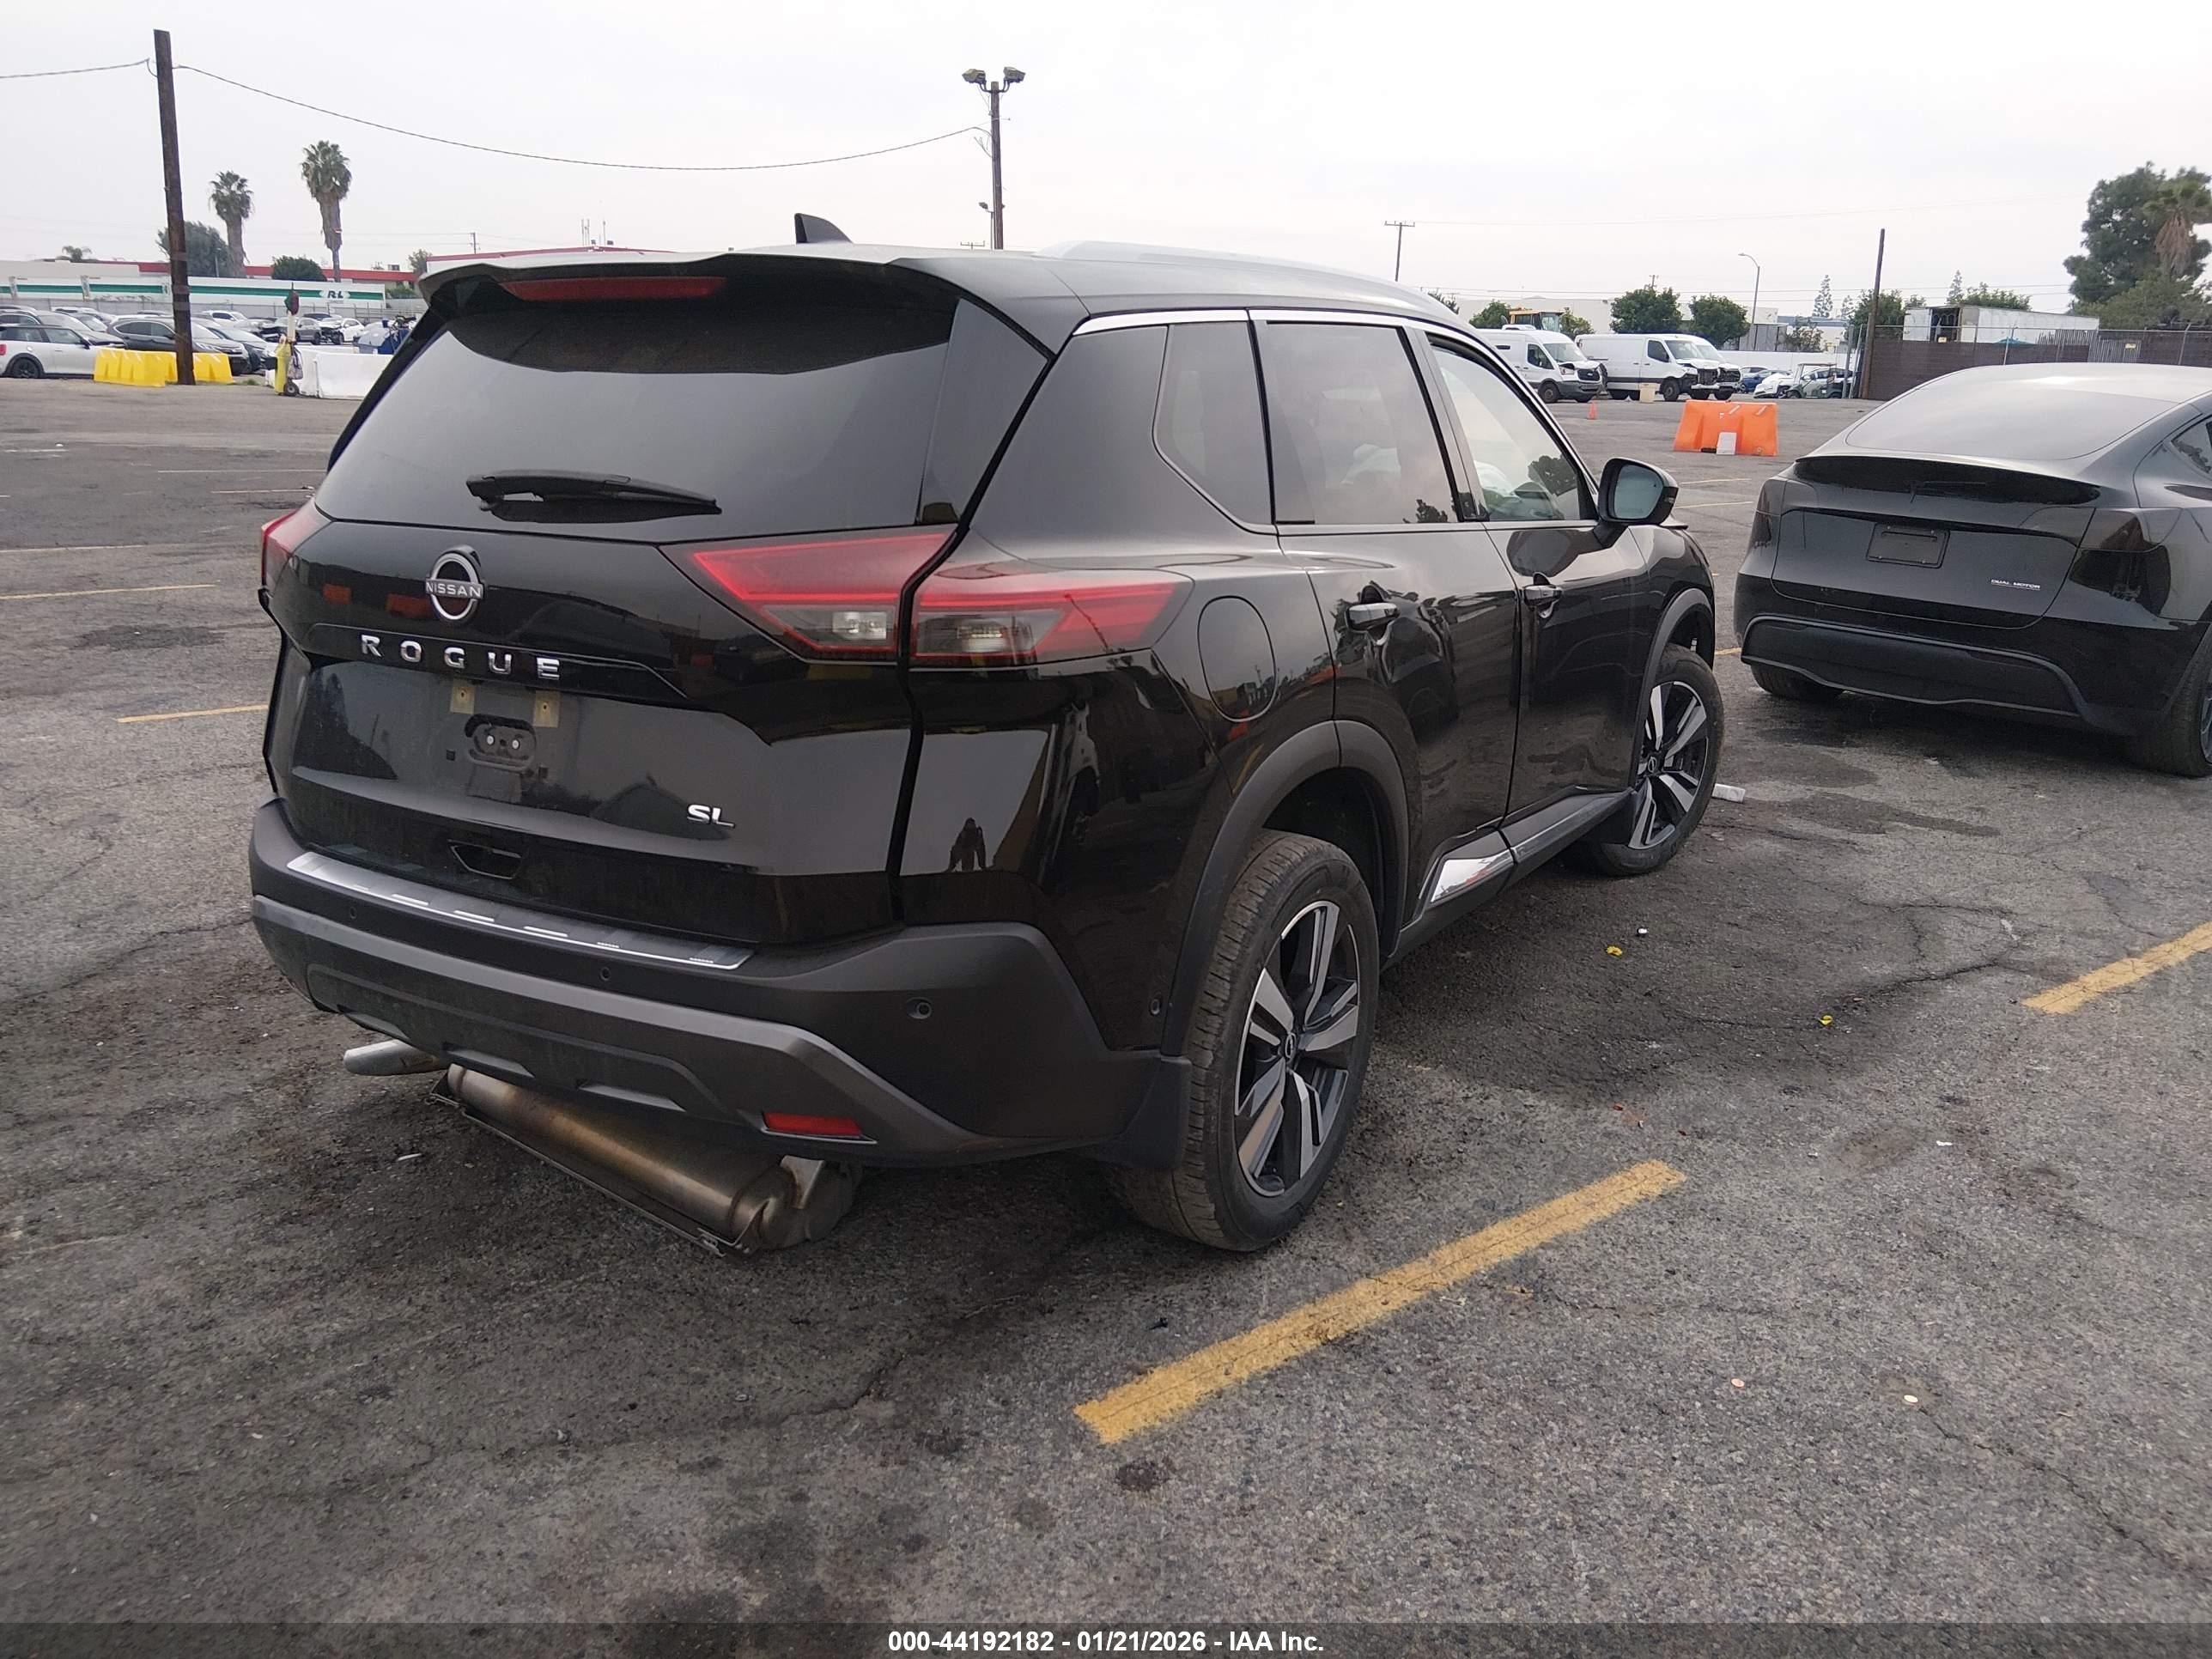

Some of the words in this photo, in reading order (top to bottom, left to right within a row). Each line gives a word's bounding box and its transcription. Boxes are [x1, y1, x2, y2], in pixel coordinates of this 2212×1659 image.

[426, 582, 481, 598] NISSAN
[361, 634, 560, 680] ROGUE
[687, 804, 735, 827] SL
